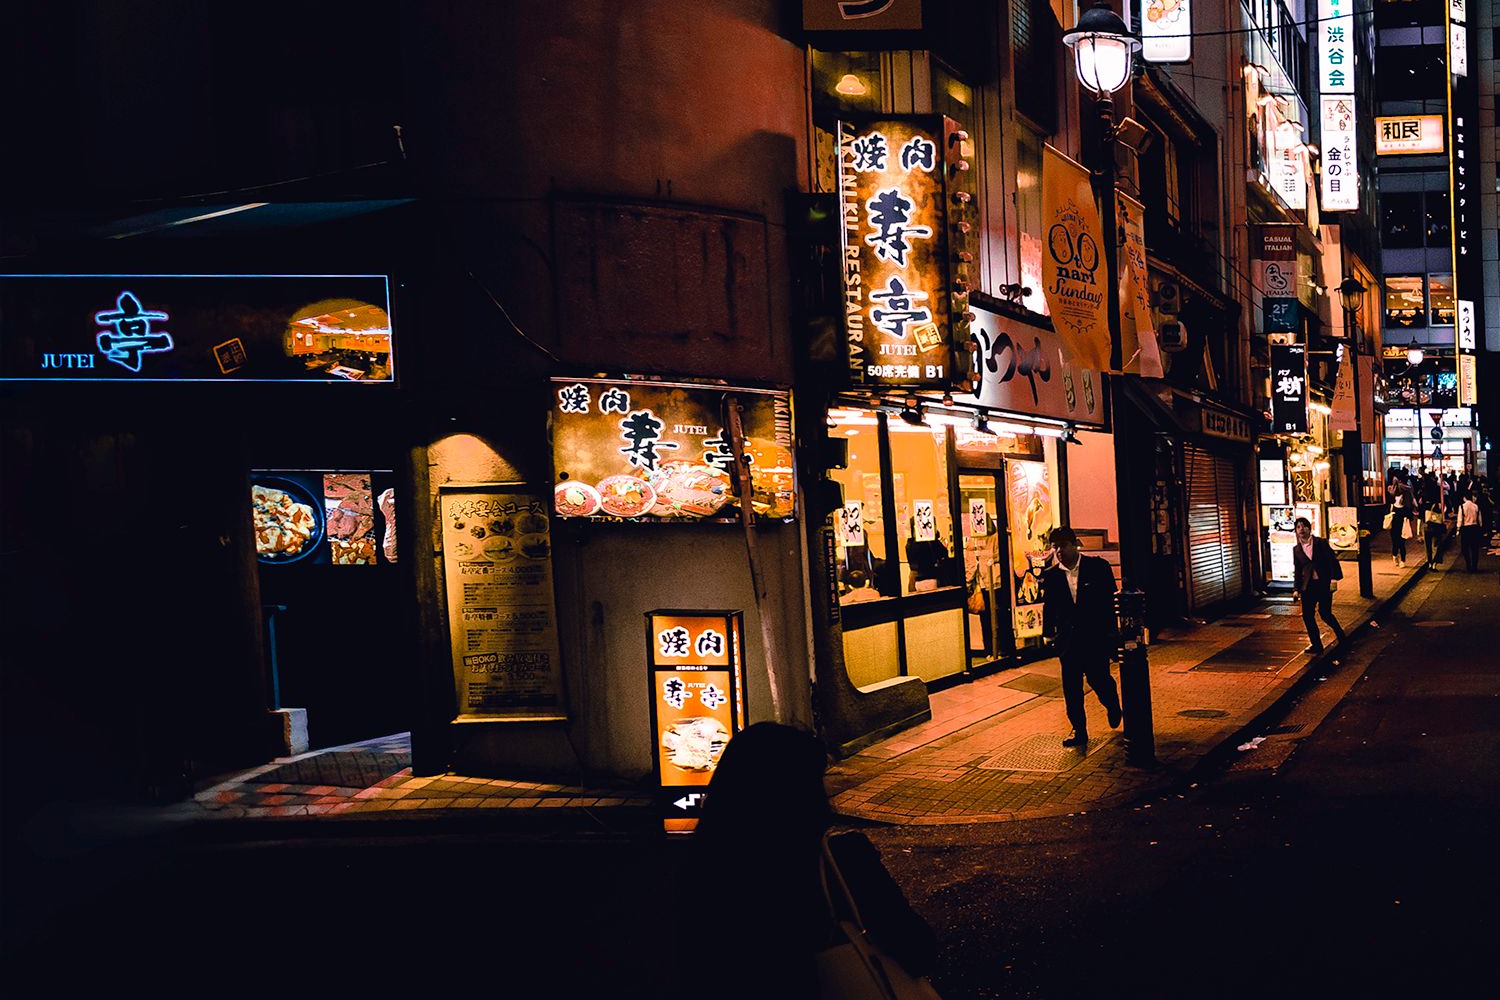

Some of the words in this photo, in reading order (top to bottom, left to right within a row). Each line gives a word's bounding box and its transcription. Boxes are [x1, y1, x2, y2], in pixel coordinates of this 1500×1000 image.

[1326, 25, 1345, 87] 渋谷会
[1383, 121, 1420, 140] 和民
[852, 134, 936, 172] 焼肉
[1327, 147, 1342, 193] 金の目
[846, 245, 865, 384] RESTAURANT
[1273, 304, 1289, 315] 2F
[41, 354, 95, 370] JUTEI
[879, 344, 918, 356] JUTEI
[925, 365, 944, 379] B1
[559, 384, 631, 415] 焼肉
[673, 424, 708, 435] JUTEI
[774, 394, 791, 447] YAKINIKU
[1285, 422, 1297, 431] B1
[658, 625, 726, 658] 焼肉
